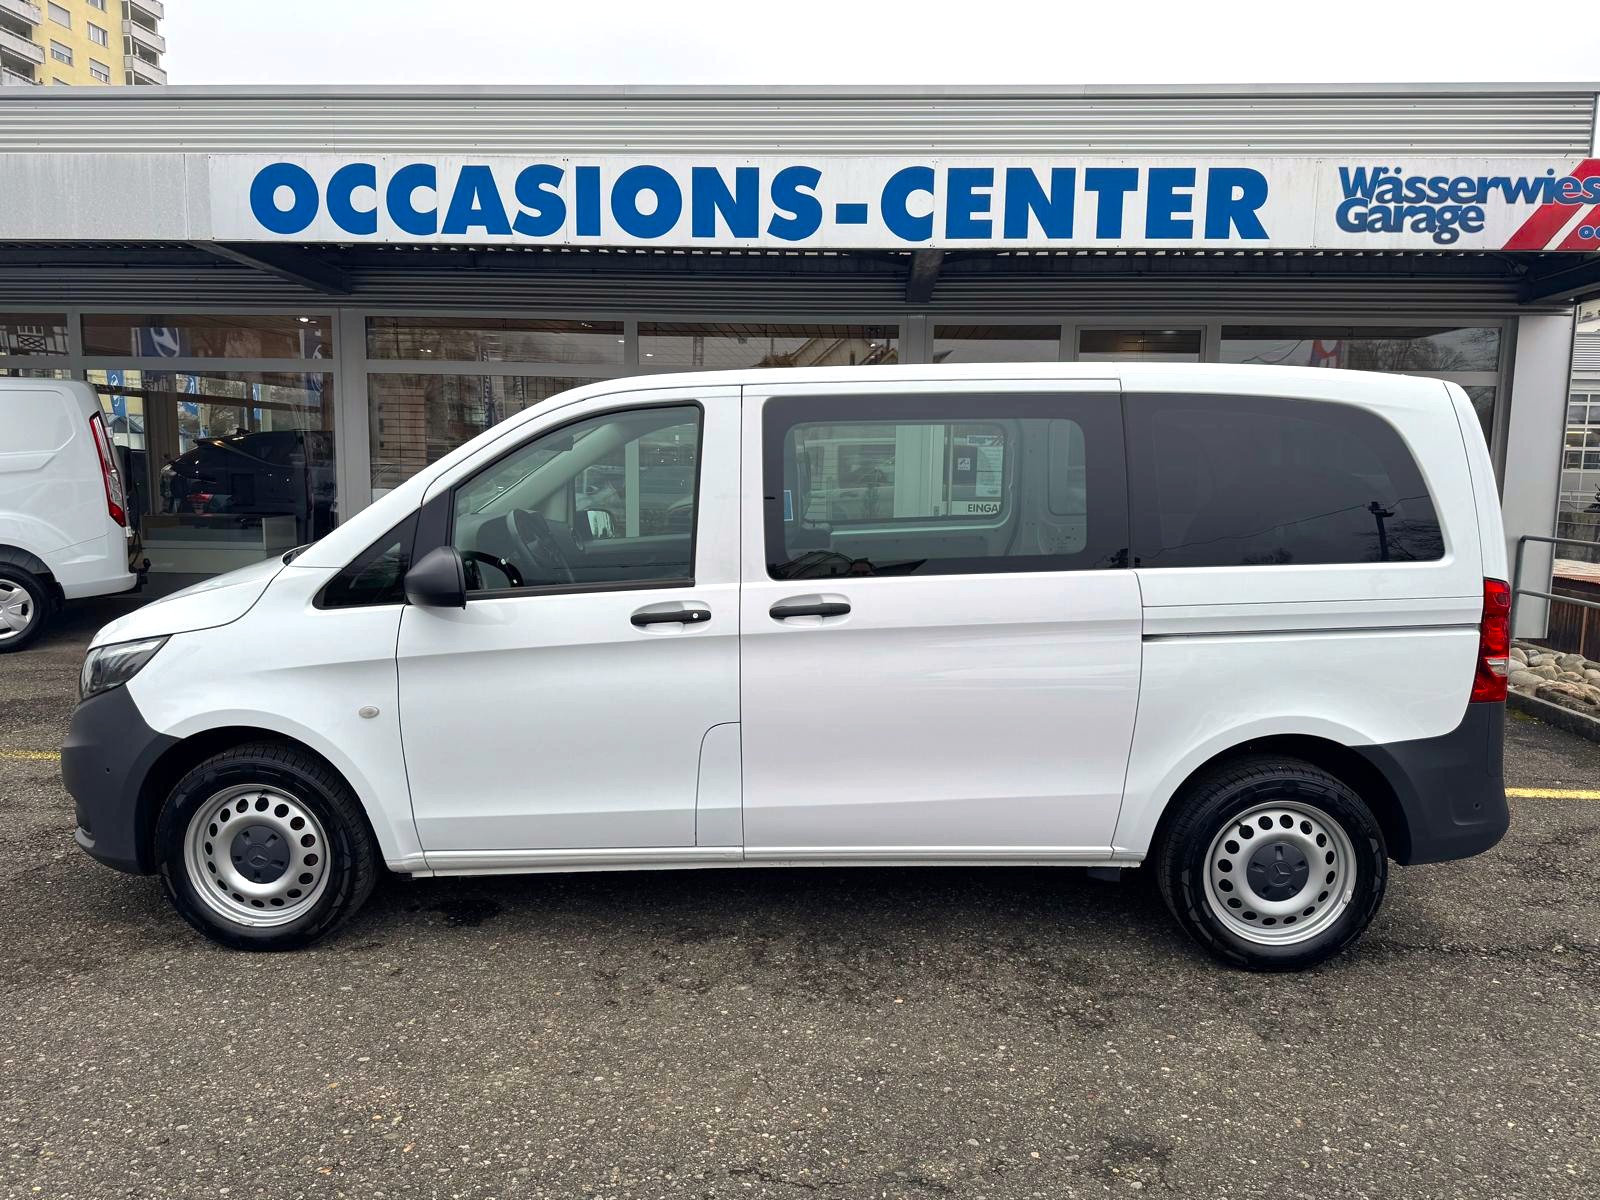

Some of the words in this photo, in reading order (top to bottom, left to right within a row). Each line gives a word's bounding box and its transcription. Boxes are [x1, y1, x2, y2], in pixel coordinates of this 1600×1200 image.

[250, 162, 1270, 242] OCCASIONS-CENTER
[1335, 198, 1485, 245] Garage
[967, 503, 1001, 513] EINGA
